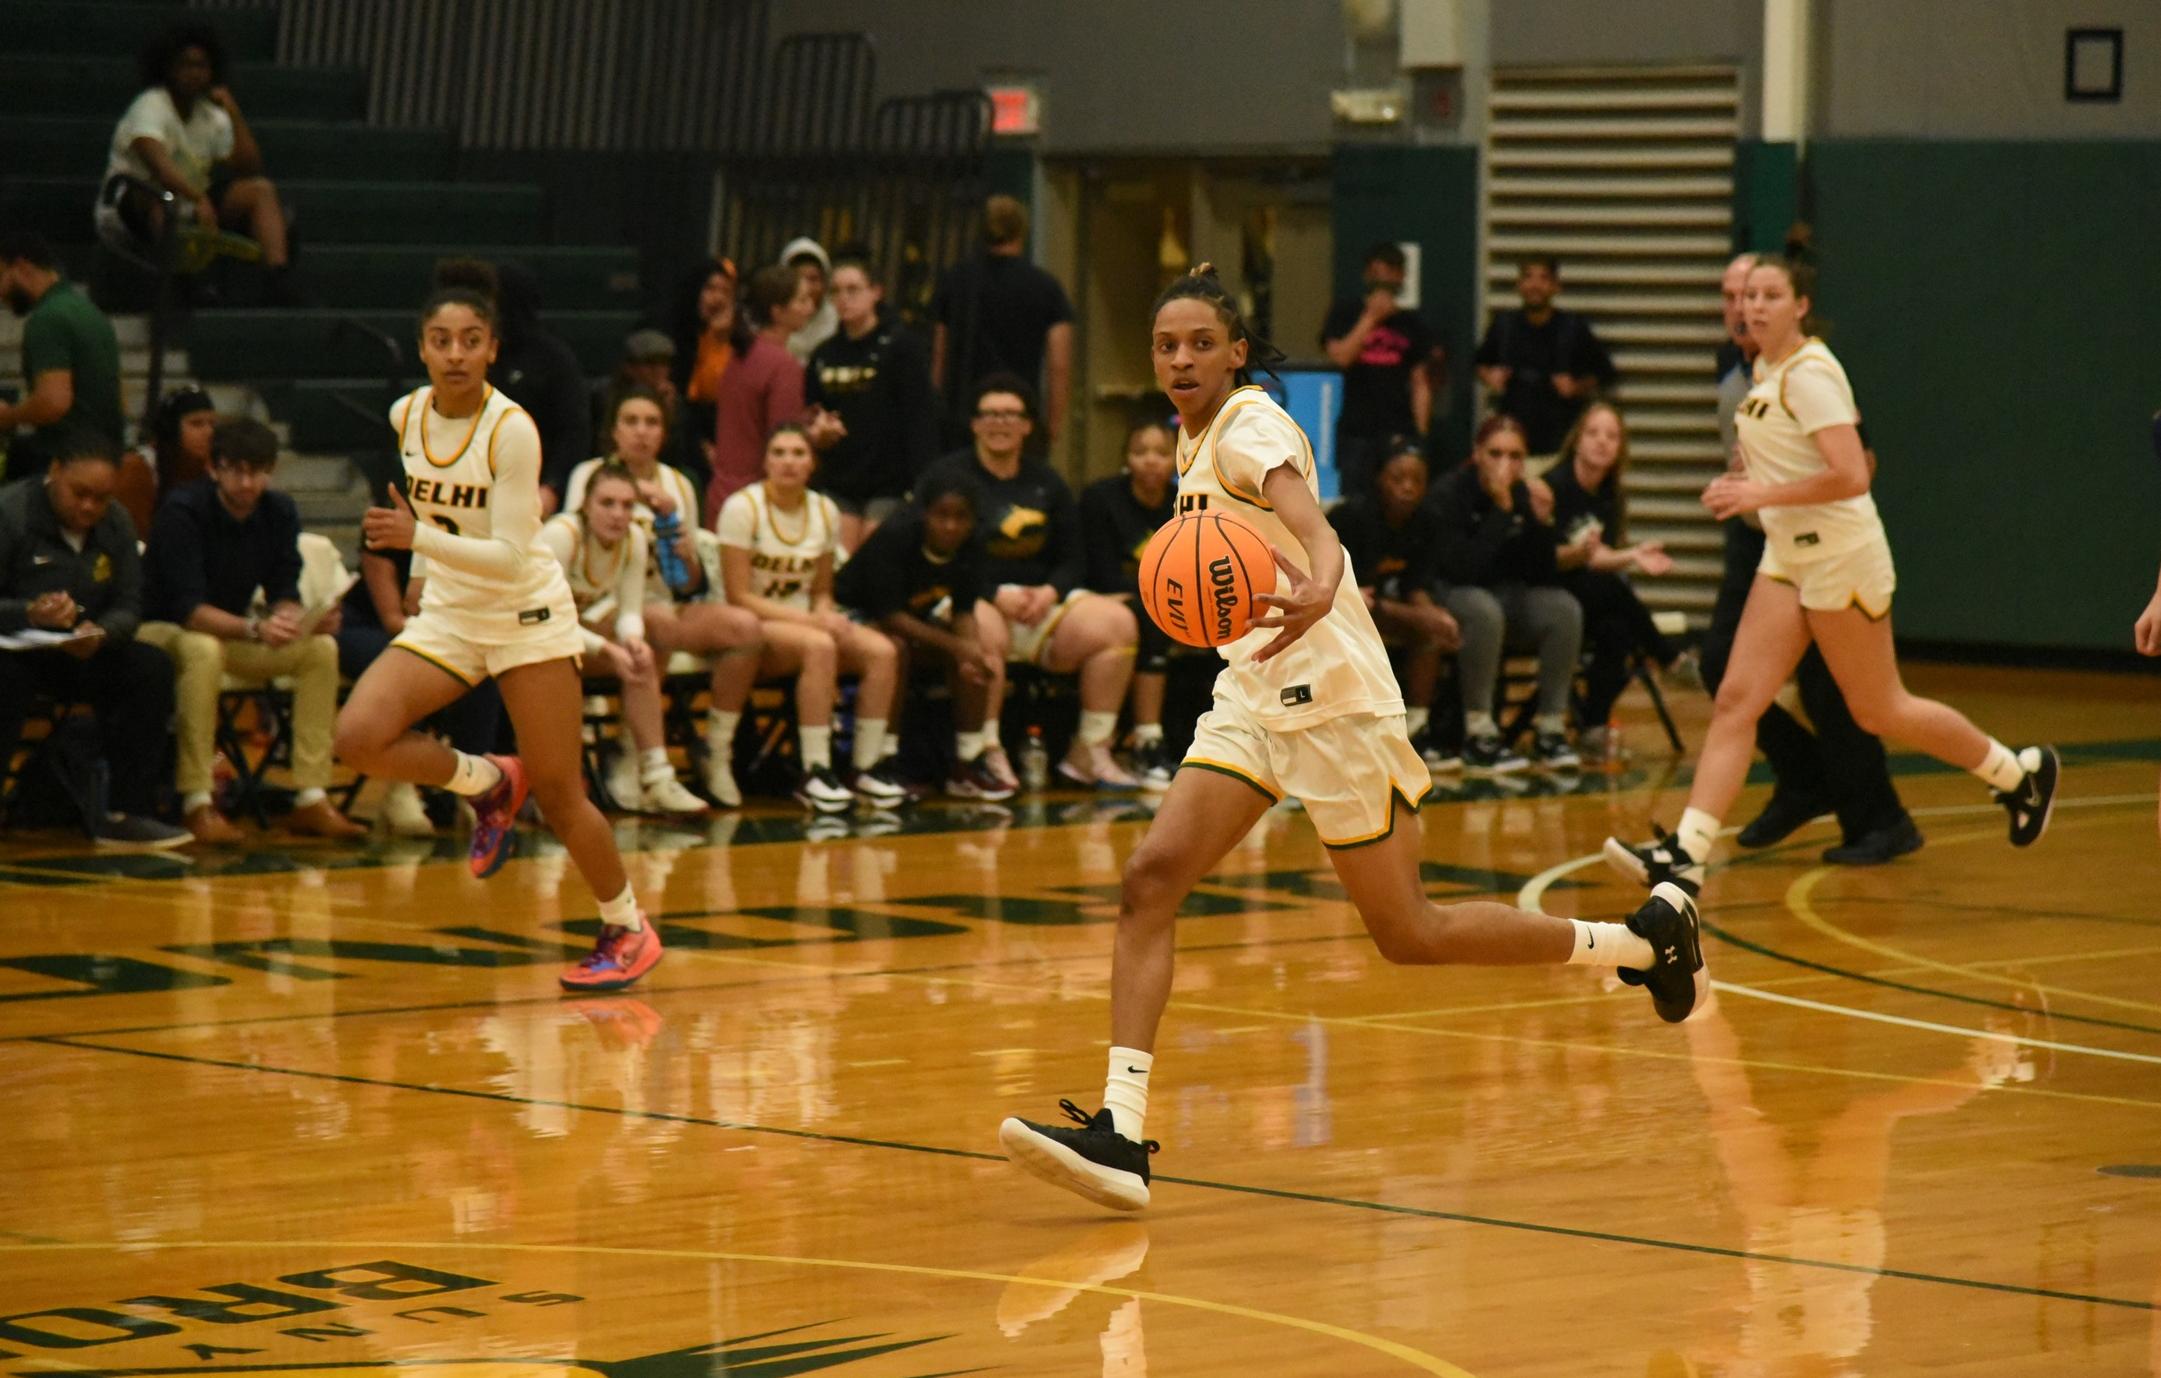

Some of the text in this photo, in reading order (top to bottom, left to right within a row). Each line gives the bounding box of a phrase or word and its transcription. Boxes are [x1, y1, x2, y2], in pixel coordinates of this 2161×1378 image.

[1209, 556, 1238, 640] Wilson
[0, 1260, 501, 1359] BRO
[179, 1290, 586, 1360] SUNY
